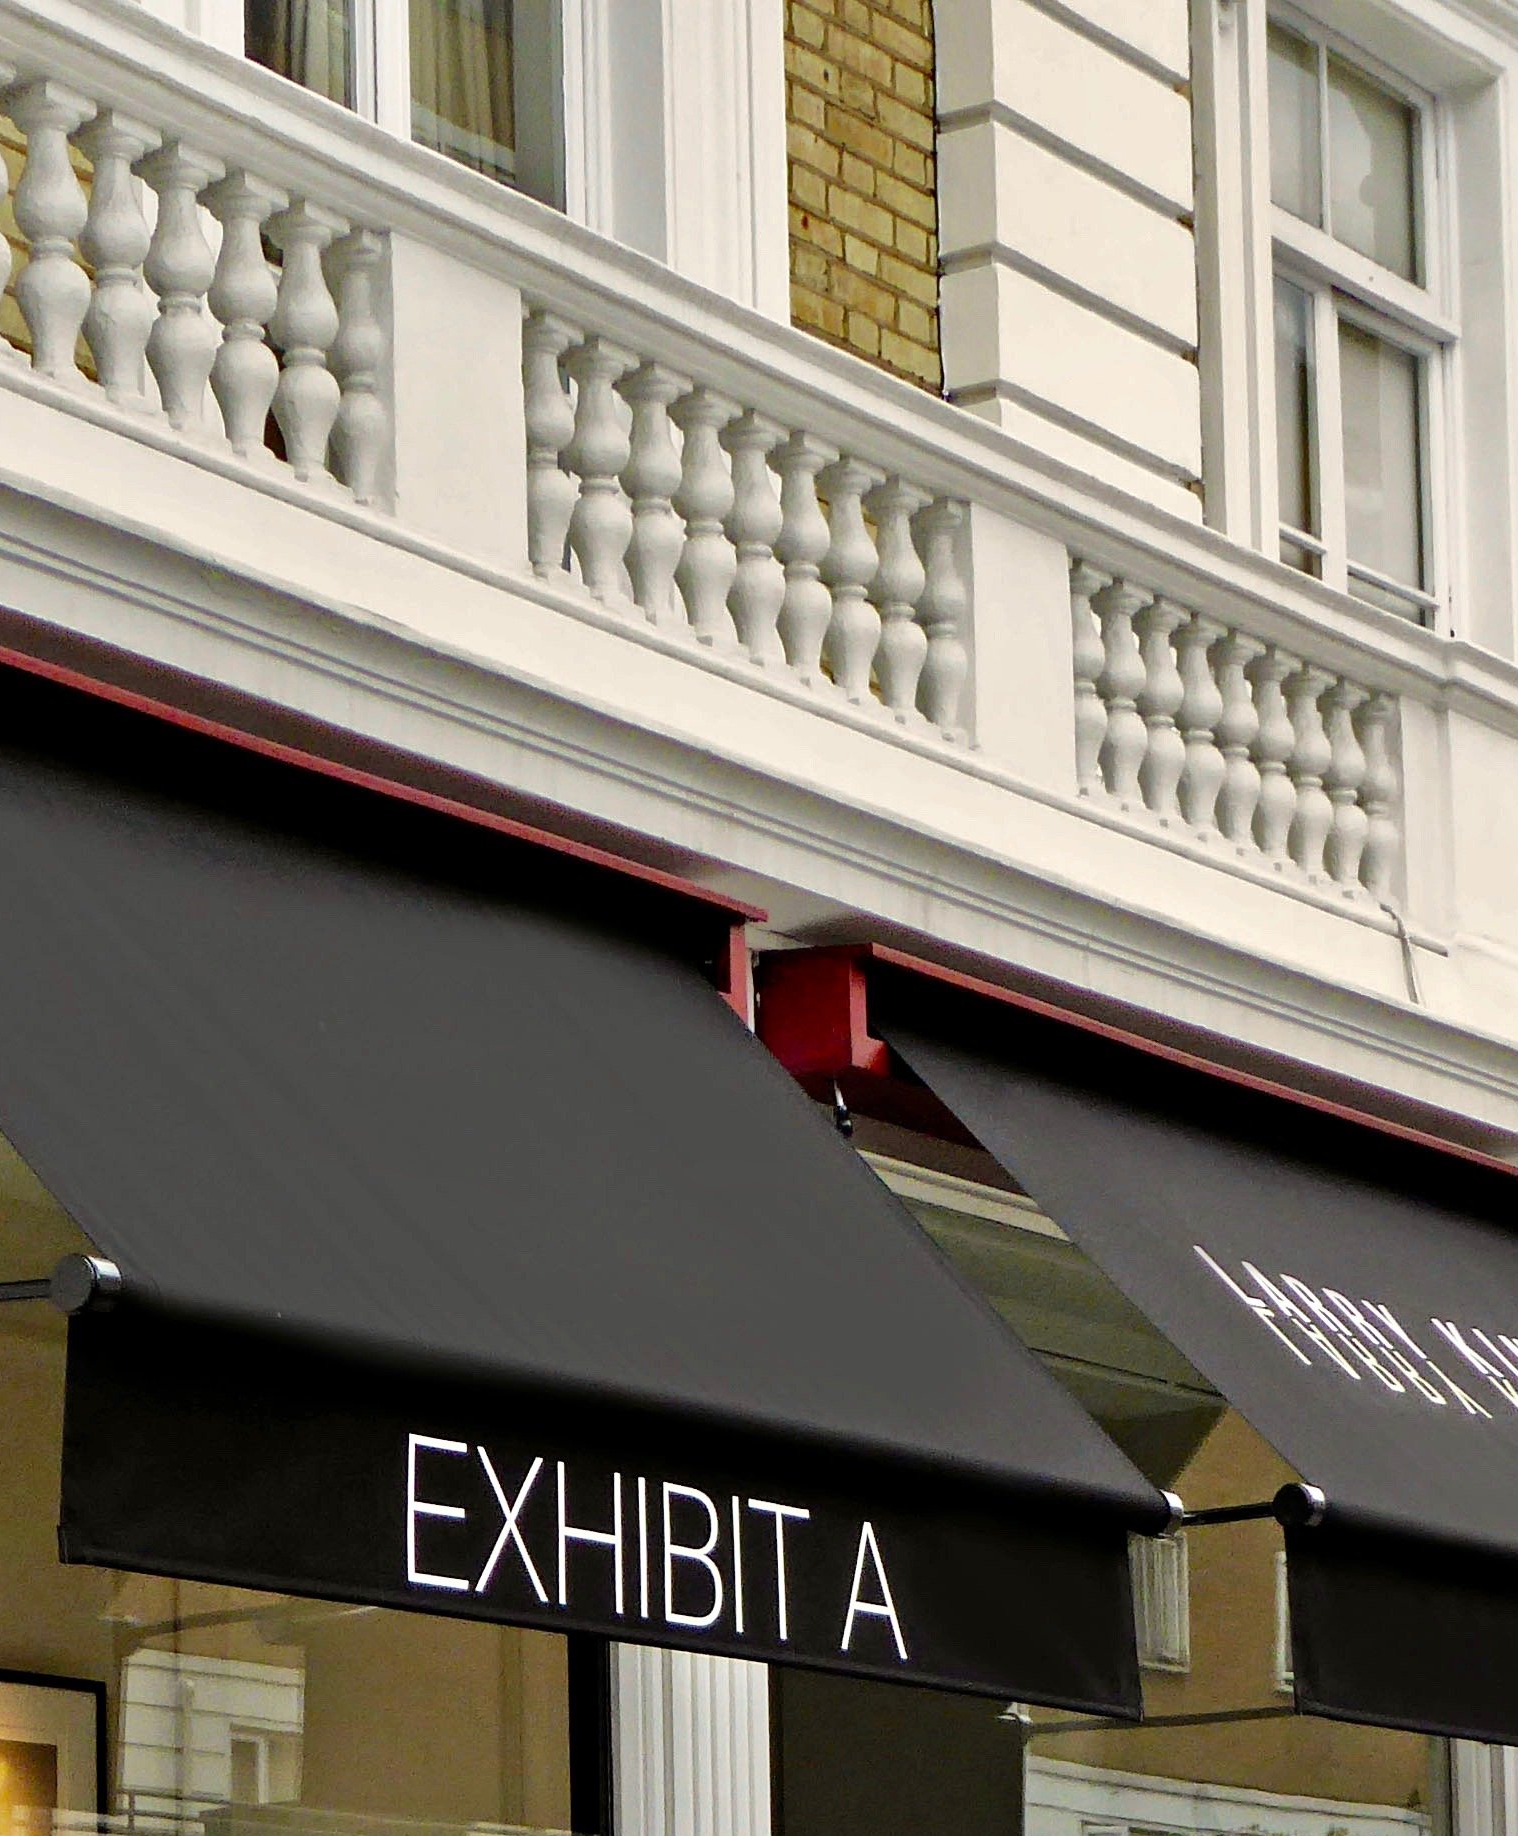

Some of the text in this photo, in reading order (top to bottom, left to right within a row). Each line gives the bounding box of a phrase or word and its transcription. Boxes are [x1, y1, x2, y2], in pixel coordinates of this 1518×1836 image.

[1193, 1245, 1427, 1359] LARRY
[406, 1433, 908, 1660] EXHIBIT A
